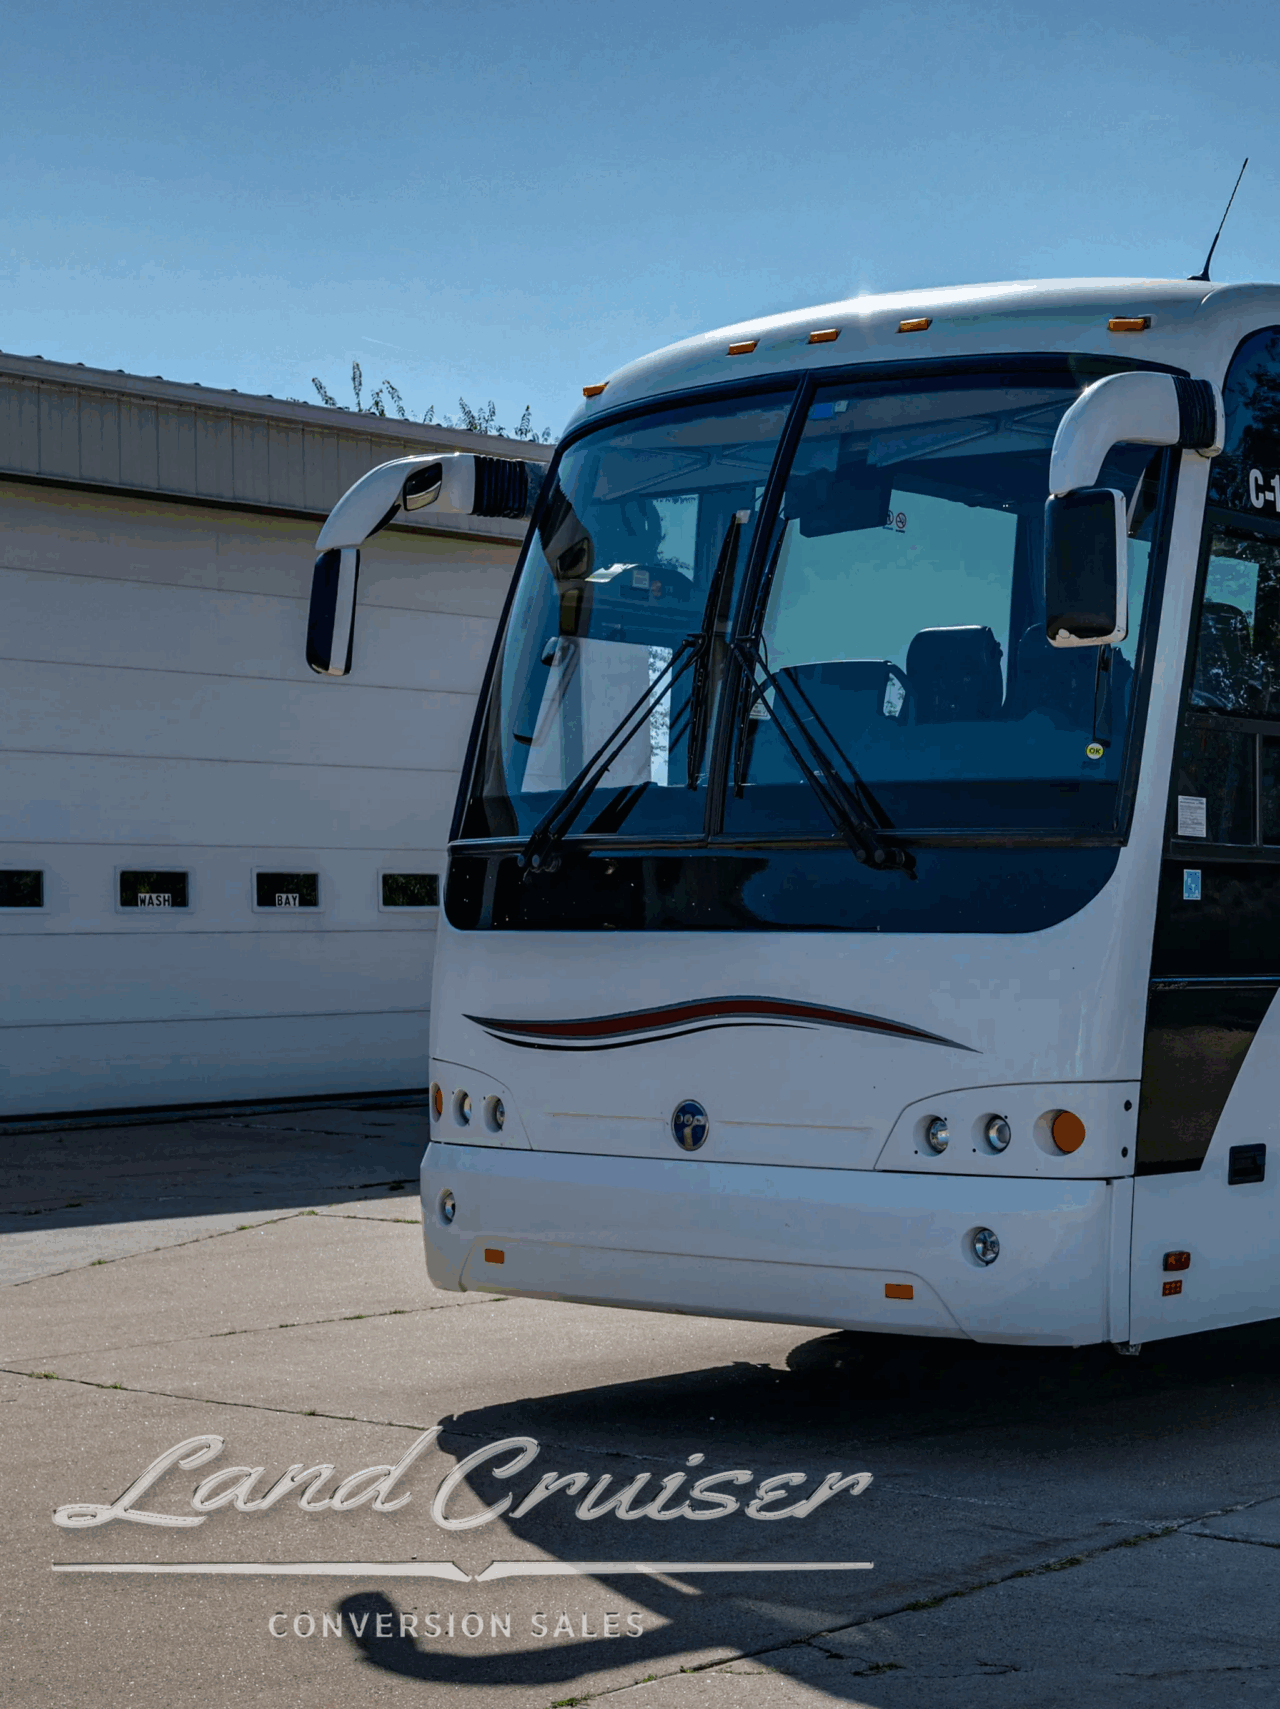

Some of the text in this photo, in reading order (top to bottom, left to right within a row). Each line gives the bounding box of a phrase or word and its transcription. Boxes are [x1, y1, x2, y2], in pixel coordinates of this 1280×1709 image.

[1089, 747, 1102, 755] OK
[138, 894, 298, 907] WASH BAY
